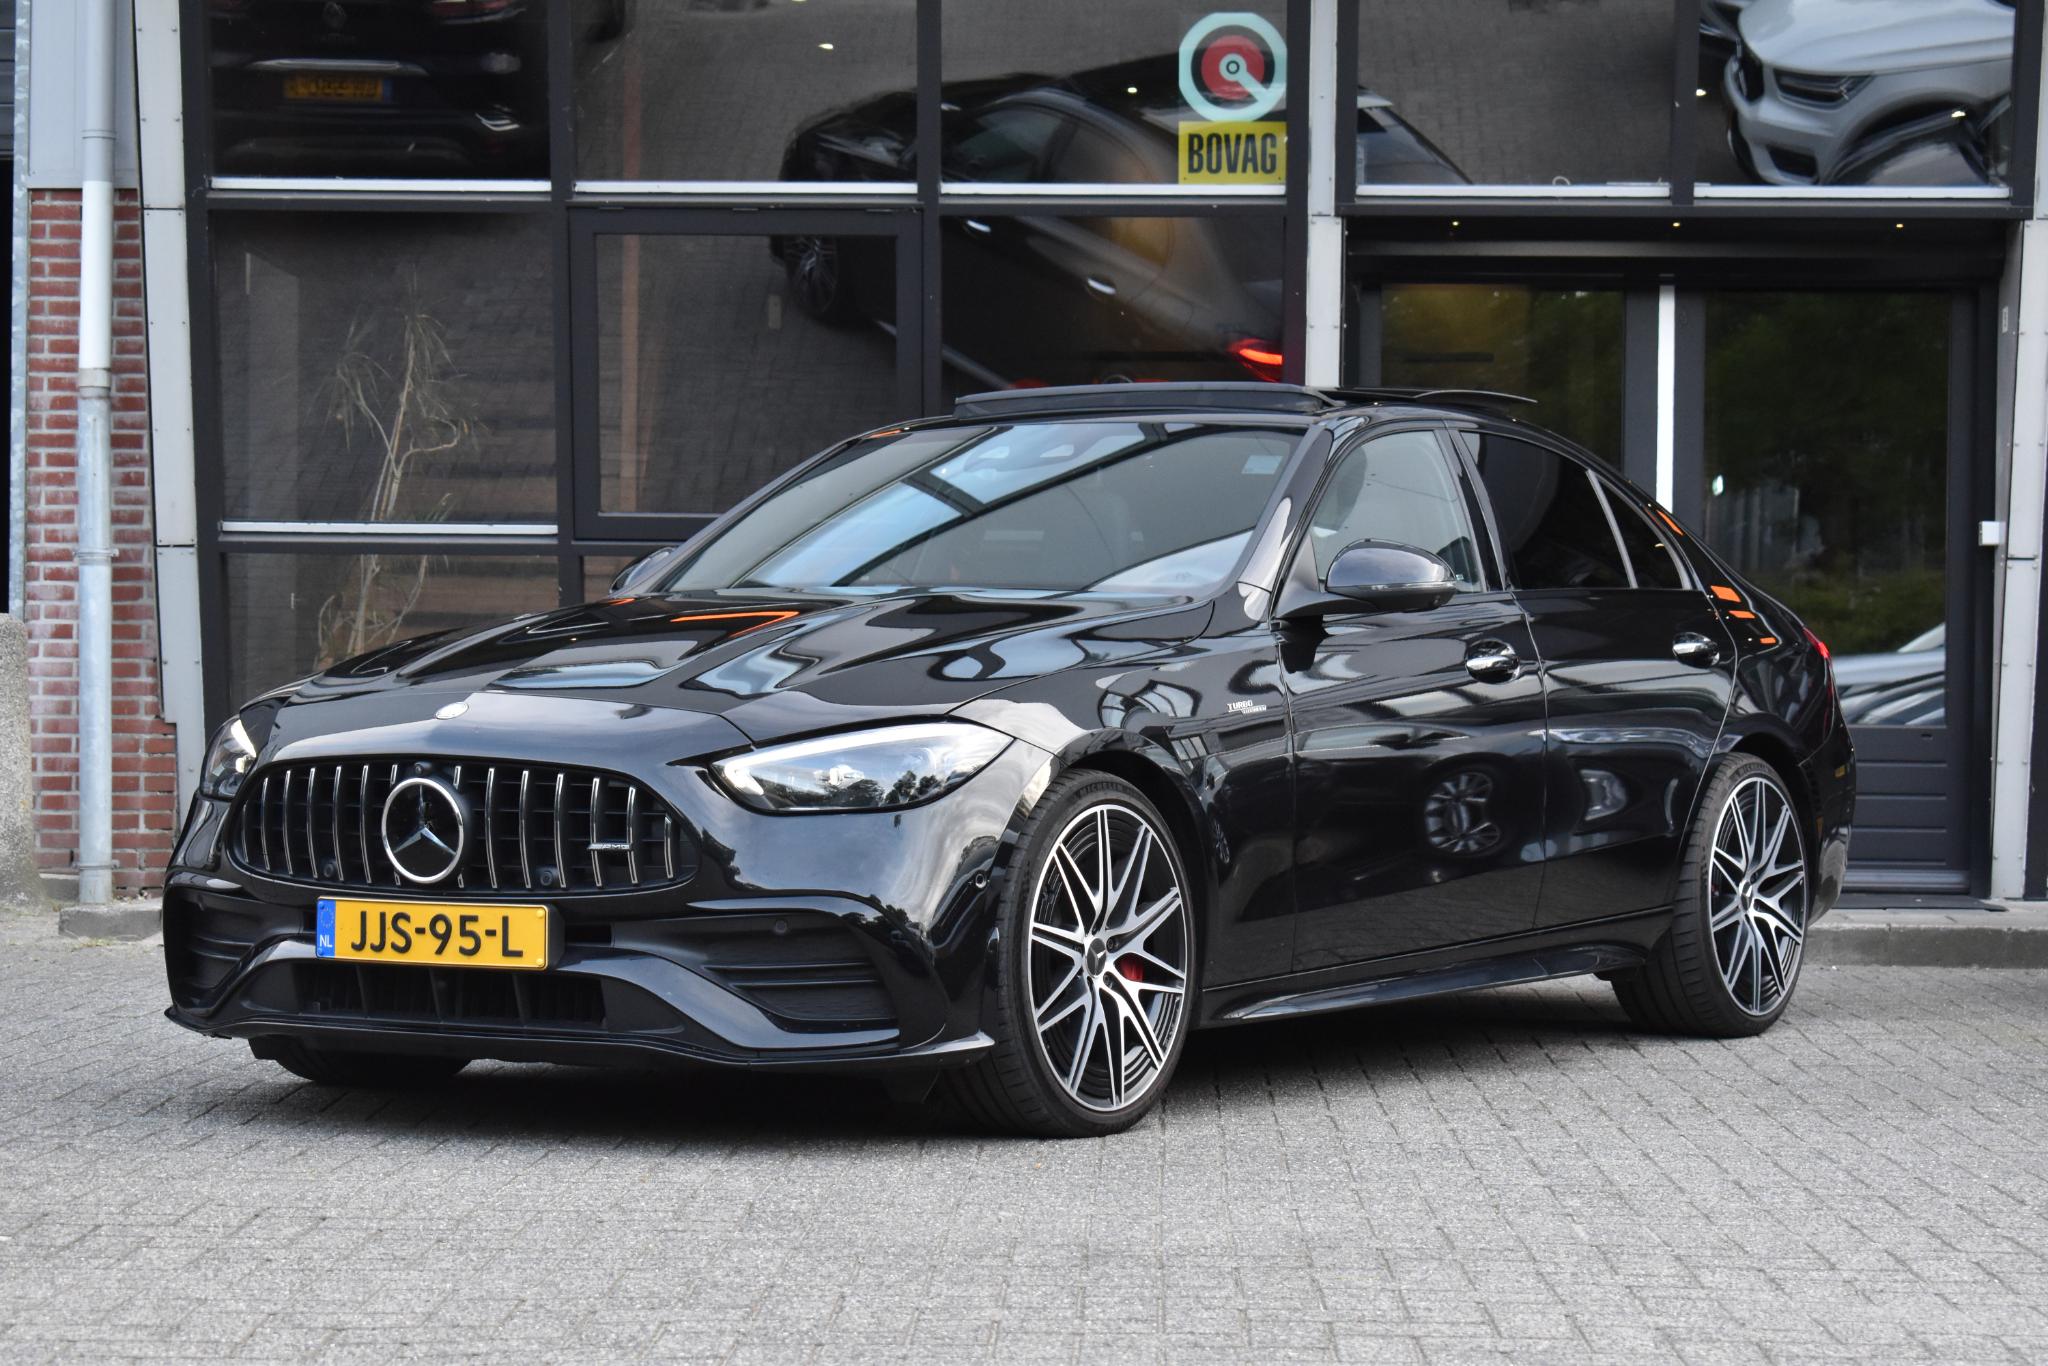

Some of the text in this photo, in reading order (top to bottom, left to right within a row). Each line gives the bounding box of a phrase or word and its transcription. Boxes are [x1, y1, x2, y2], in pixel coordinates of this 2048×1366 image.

[1187, 132, 1277, 175] BOVAG
[319, 934, 333, 948] NL
[350, 910, 524, 958] JJS-95-L
